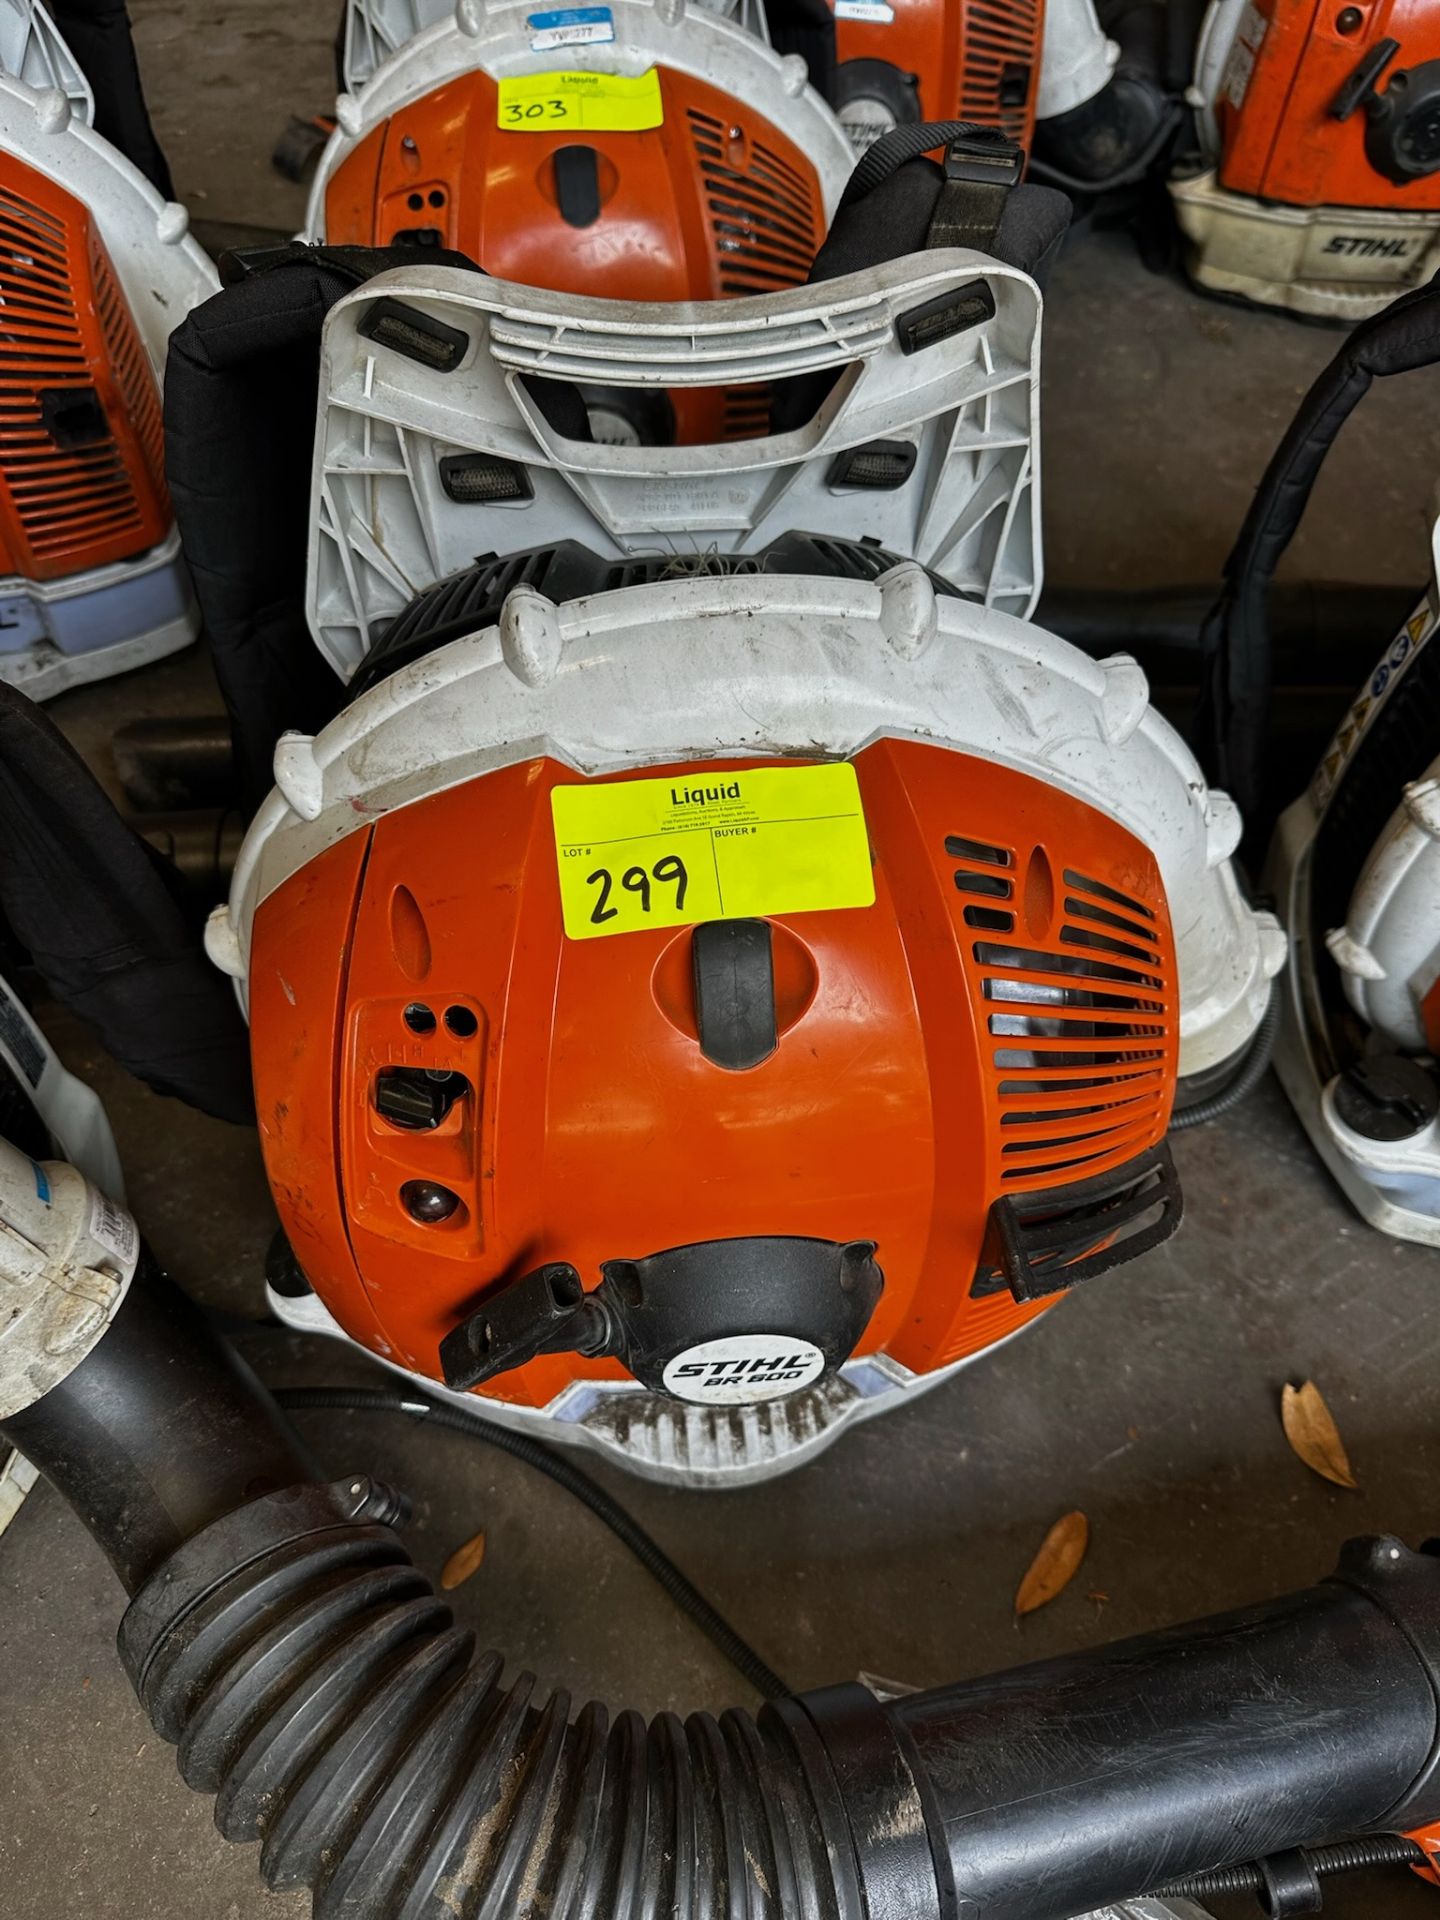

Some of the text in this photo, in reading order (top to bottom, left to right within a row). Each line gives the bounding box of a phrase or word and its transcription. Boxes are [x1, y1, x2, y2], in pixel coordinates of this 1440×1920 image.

[505, 100, 567, 122] 303
[1322, 236, 1408, 257] STIHL
[671, 782, 741, 806] Liquid
[714, 828, 749, 838] BUYER
[563, 848, 583, 857] LOT
[586, 855, 688, 924] 299
[672, 1354, 812, 1378] STIHL
[703, 1370, 803, 1387] BR 600
